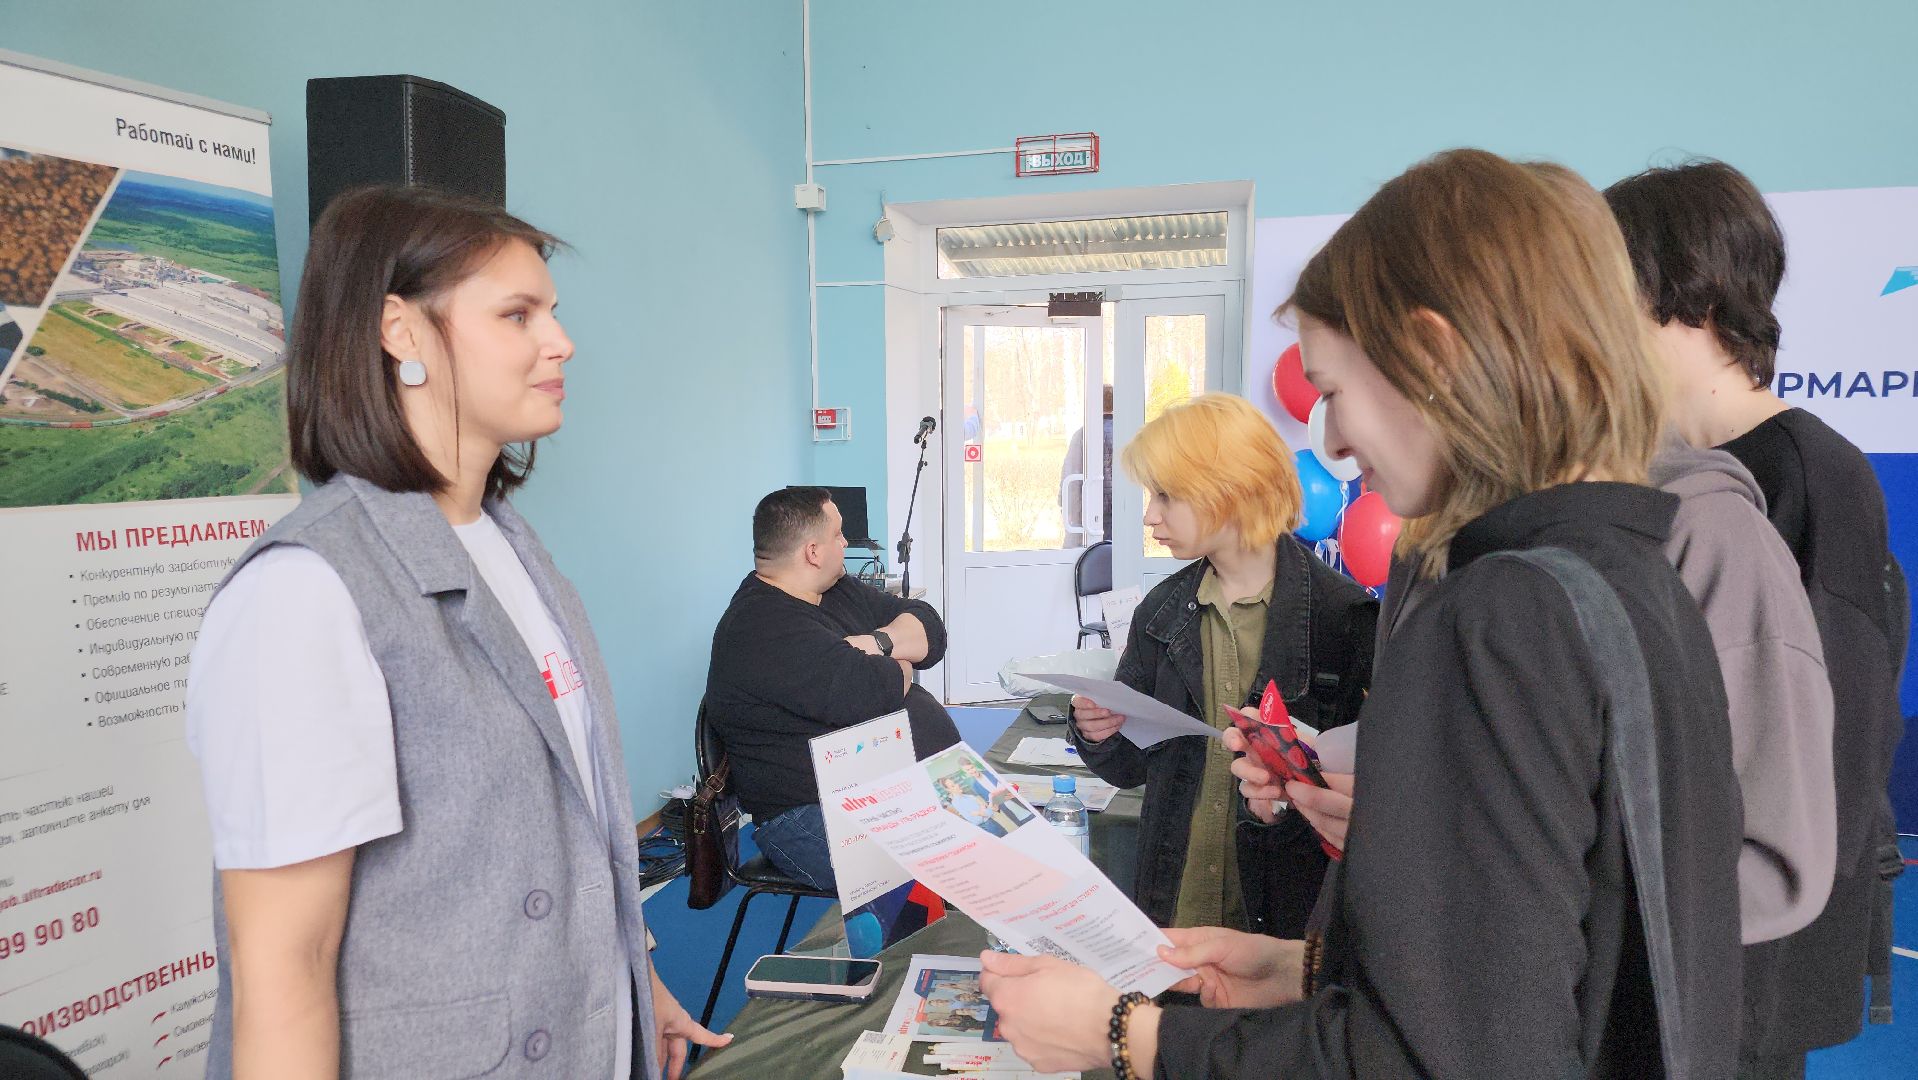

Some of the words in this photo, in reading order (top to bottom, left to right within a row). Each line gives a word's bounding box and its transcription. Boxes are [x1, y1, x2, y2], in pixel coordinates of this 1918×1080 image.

[116, 117, 194, 150] Работай
[199, 138, 208, 153] с
[213, 141, 256, 165] нами!
[1031, 151, 1084, 168] ВЫХОД
[1777, 371, 1918, 398] РМАР
[76, 529, 117, 552] МЫ
[80, 562, 165, 582] Конкурентную
[168, 556, 236, 573] заработную
[83, 589, 131, 608] Премию
[134, 588, 148, 600] по
[87, 611, 160, 631] Обеспечение
[89, 631, 184, 655] Индивидуальную
[92, 656, 171, 680] Современную
[94, 680, 170, 705] Официальное
[98, 704, 179, 728] Возможность
[89, 801, 129, 821] анкету
[133, 796, 151, 811] для
[34, 919, 63, 946] 90
[72, 907, 100, 934] 80
